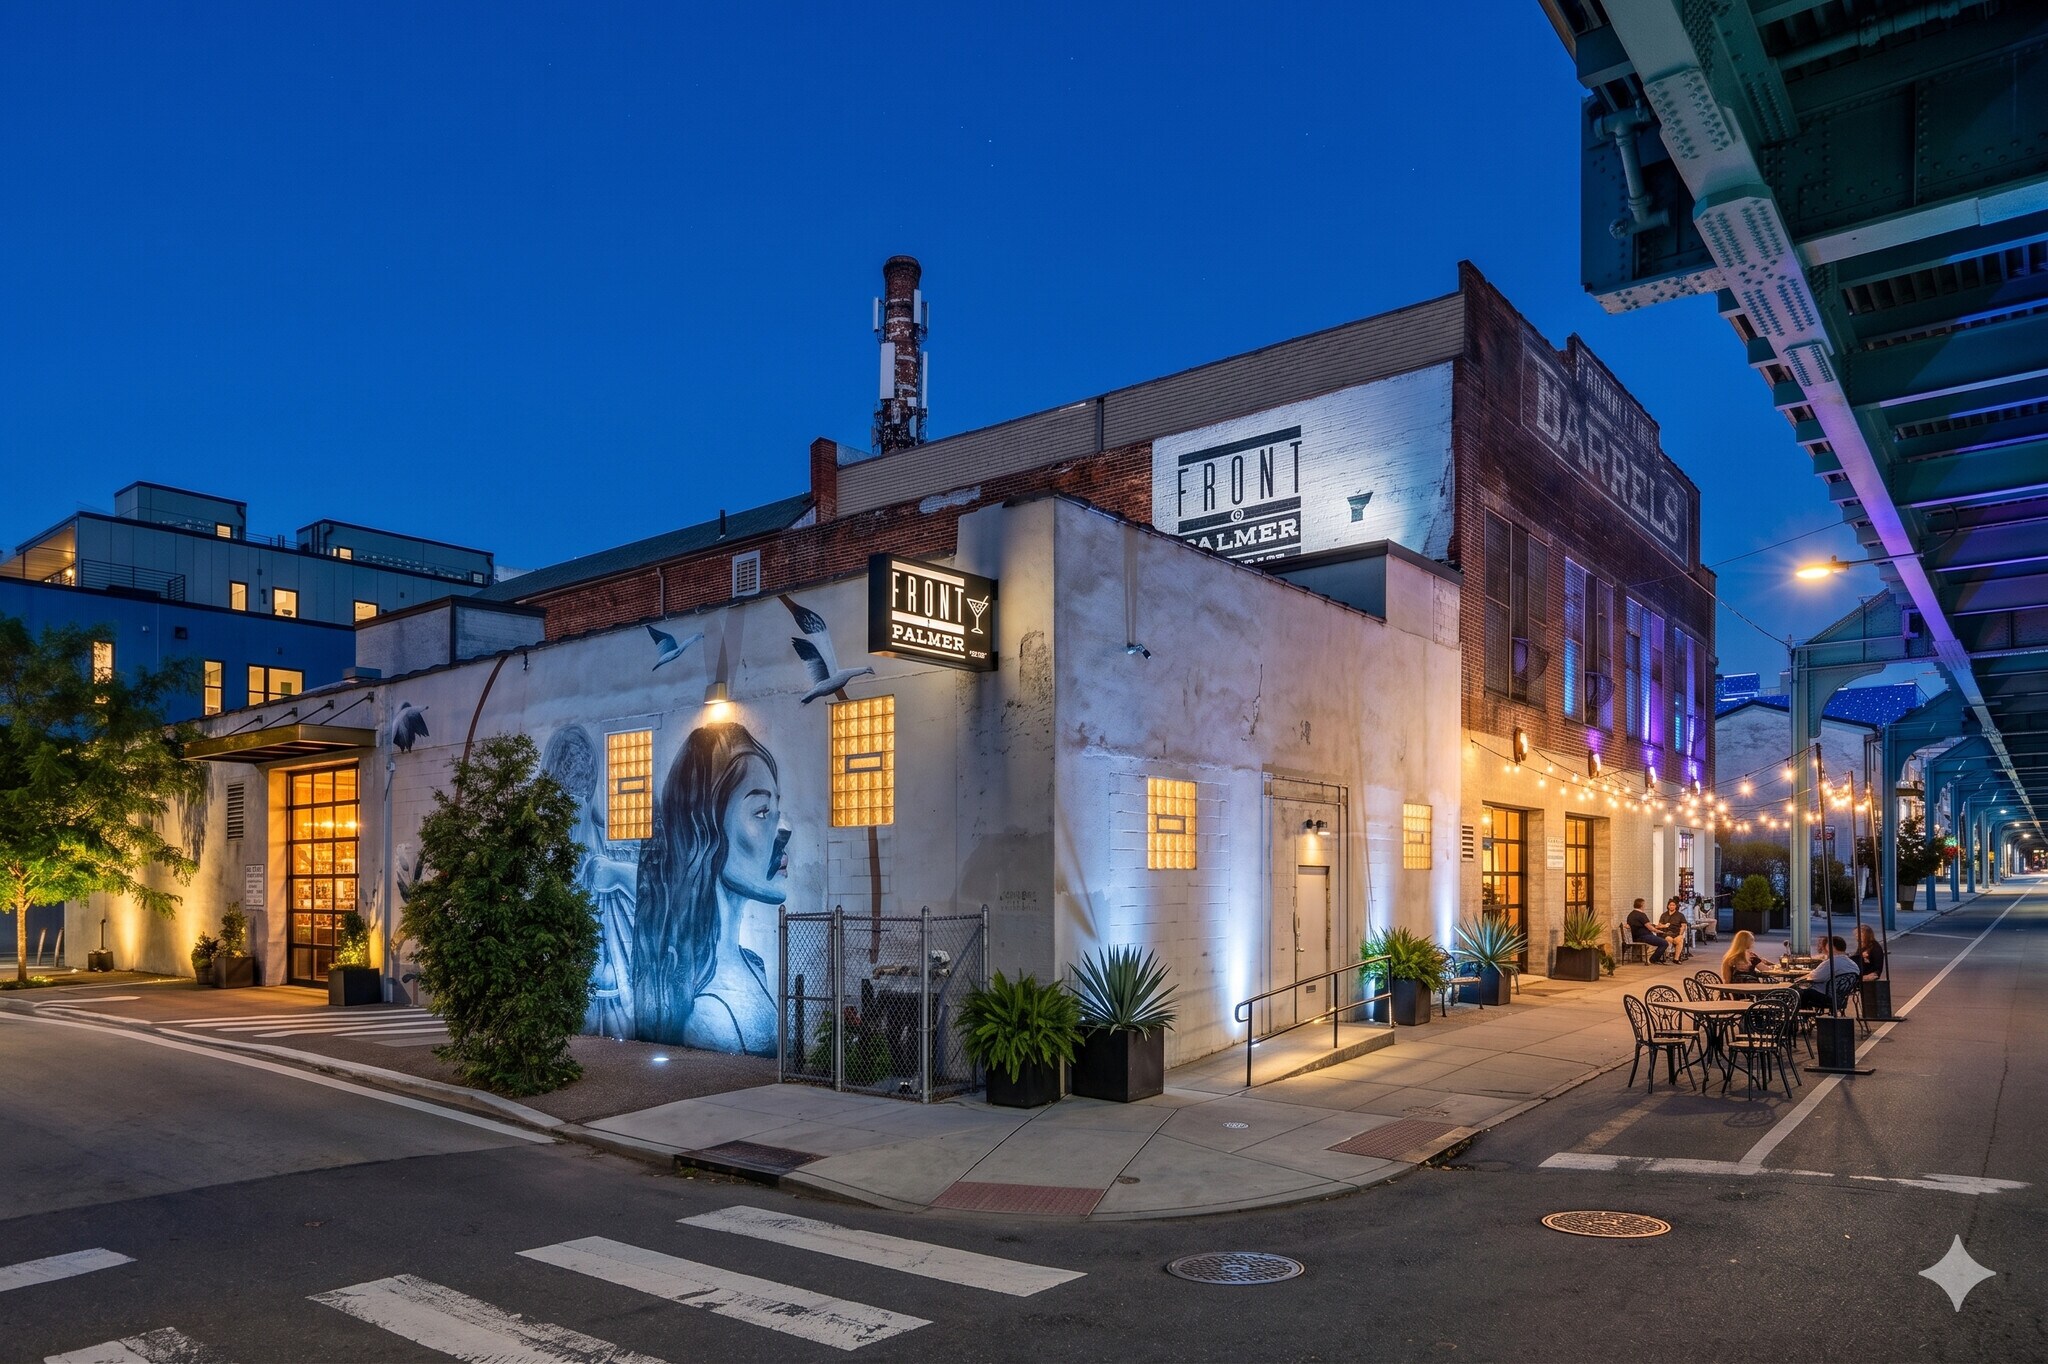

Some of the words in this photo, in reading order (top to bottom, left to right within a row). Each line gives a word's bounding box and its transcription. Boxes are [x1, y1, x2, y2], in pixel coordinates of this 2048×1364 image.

[1178, 440, 1303, 517] FRONT
[892, 571, 965, 623] FRONT
[892, 624, 965, 652] PALMER
